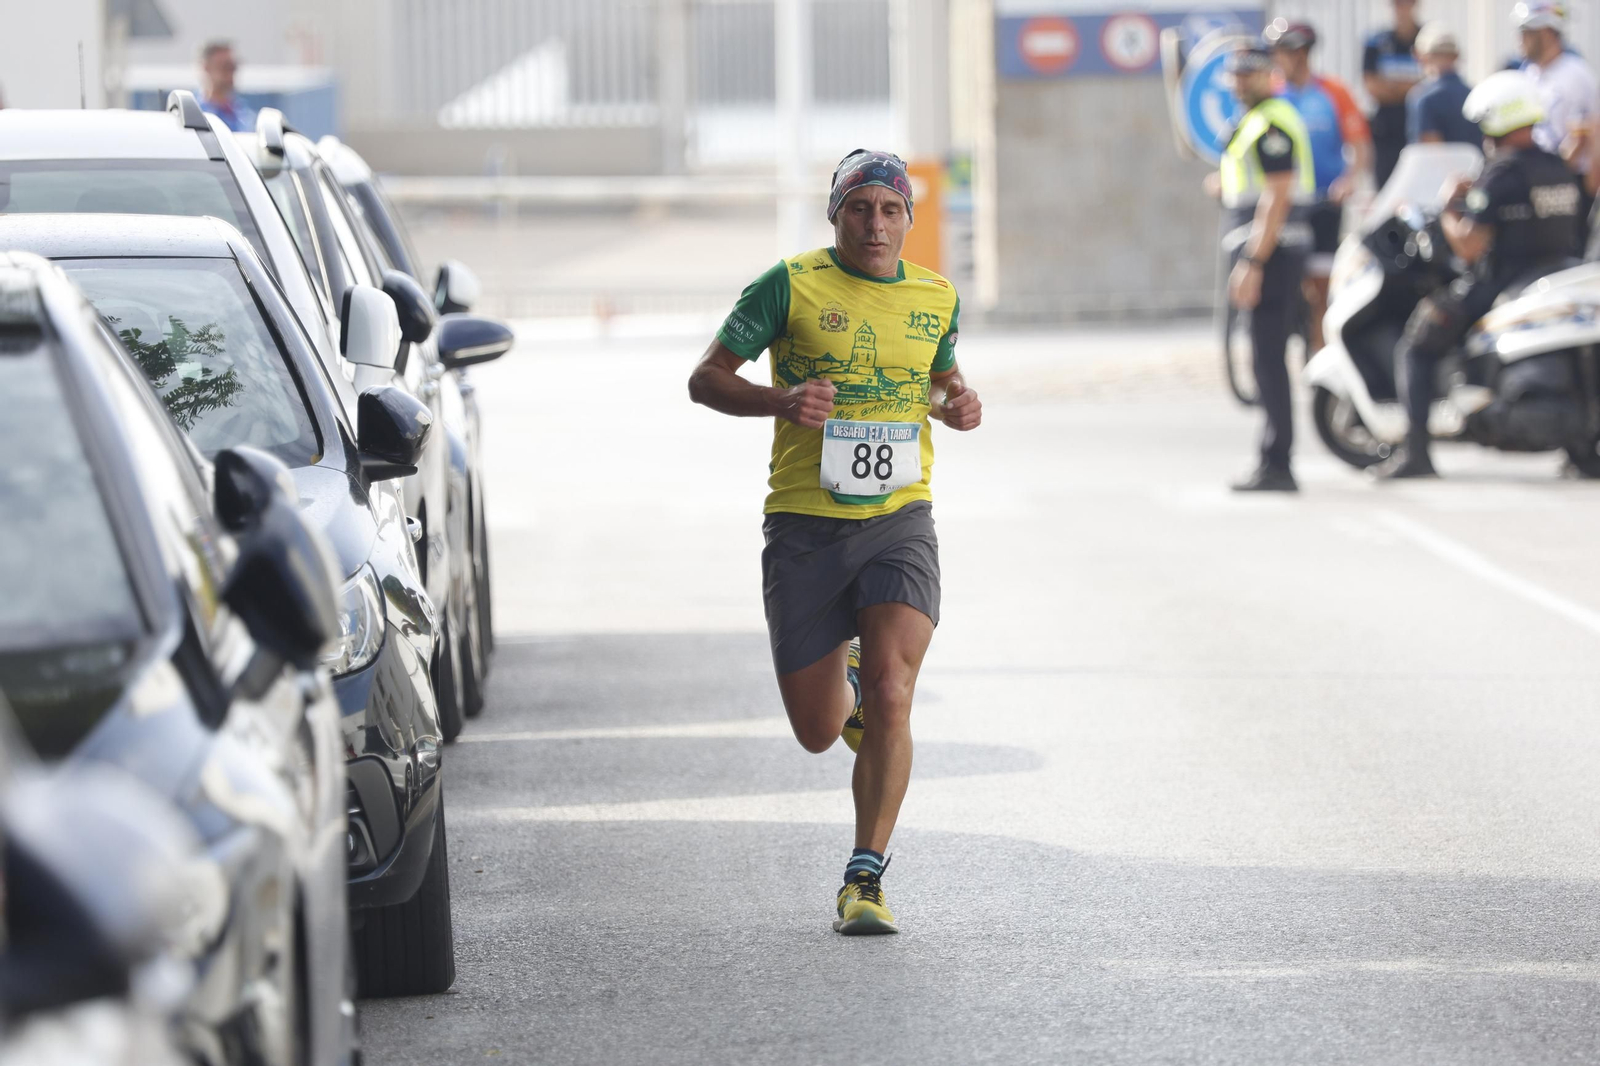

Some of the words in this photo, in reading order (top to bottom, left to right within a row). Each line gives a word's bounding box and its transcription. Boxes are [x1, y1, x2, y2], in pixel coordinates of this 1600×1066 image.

[861, 401, 912, 417] BARRIOS
[868, 425, 889, 442] ELA
[890, 428, 912, 441] TARIFA
[851, 443, 894, 480] 88
